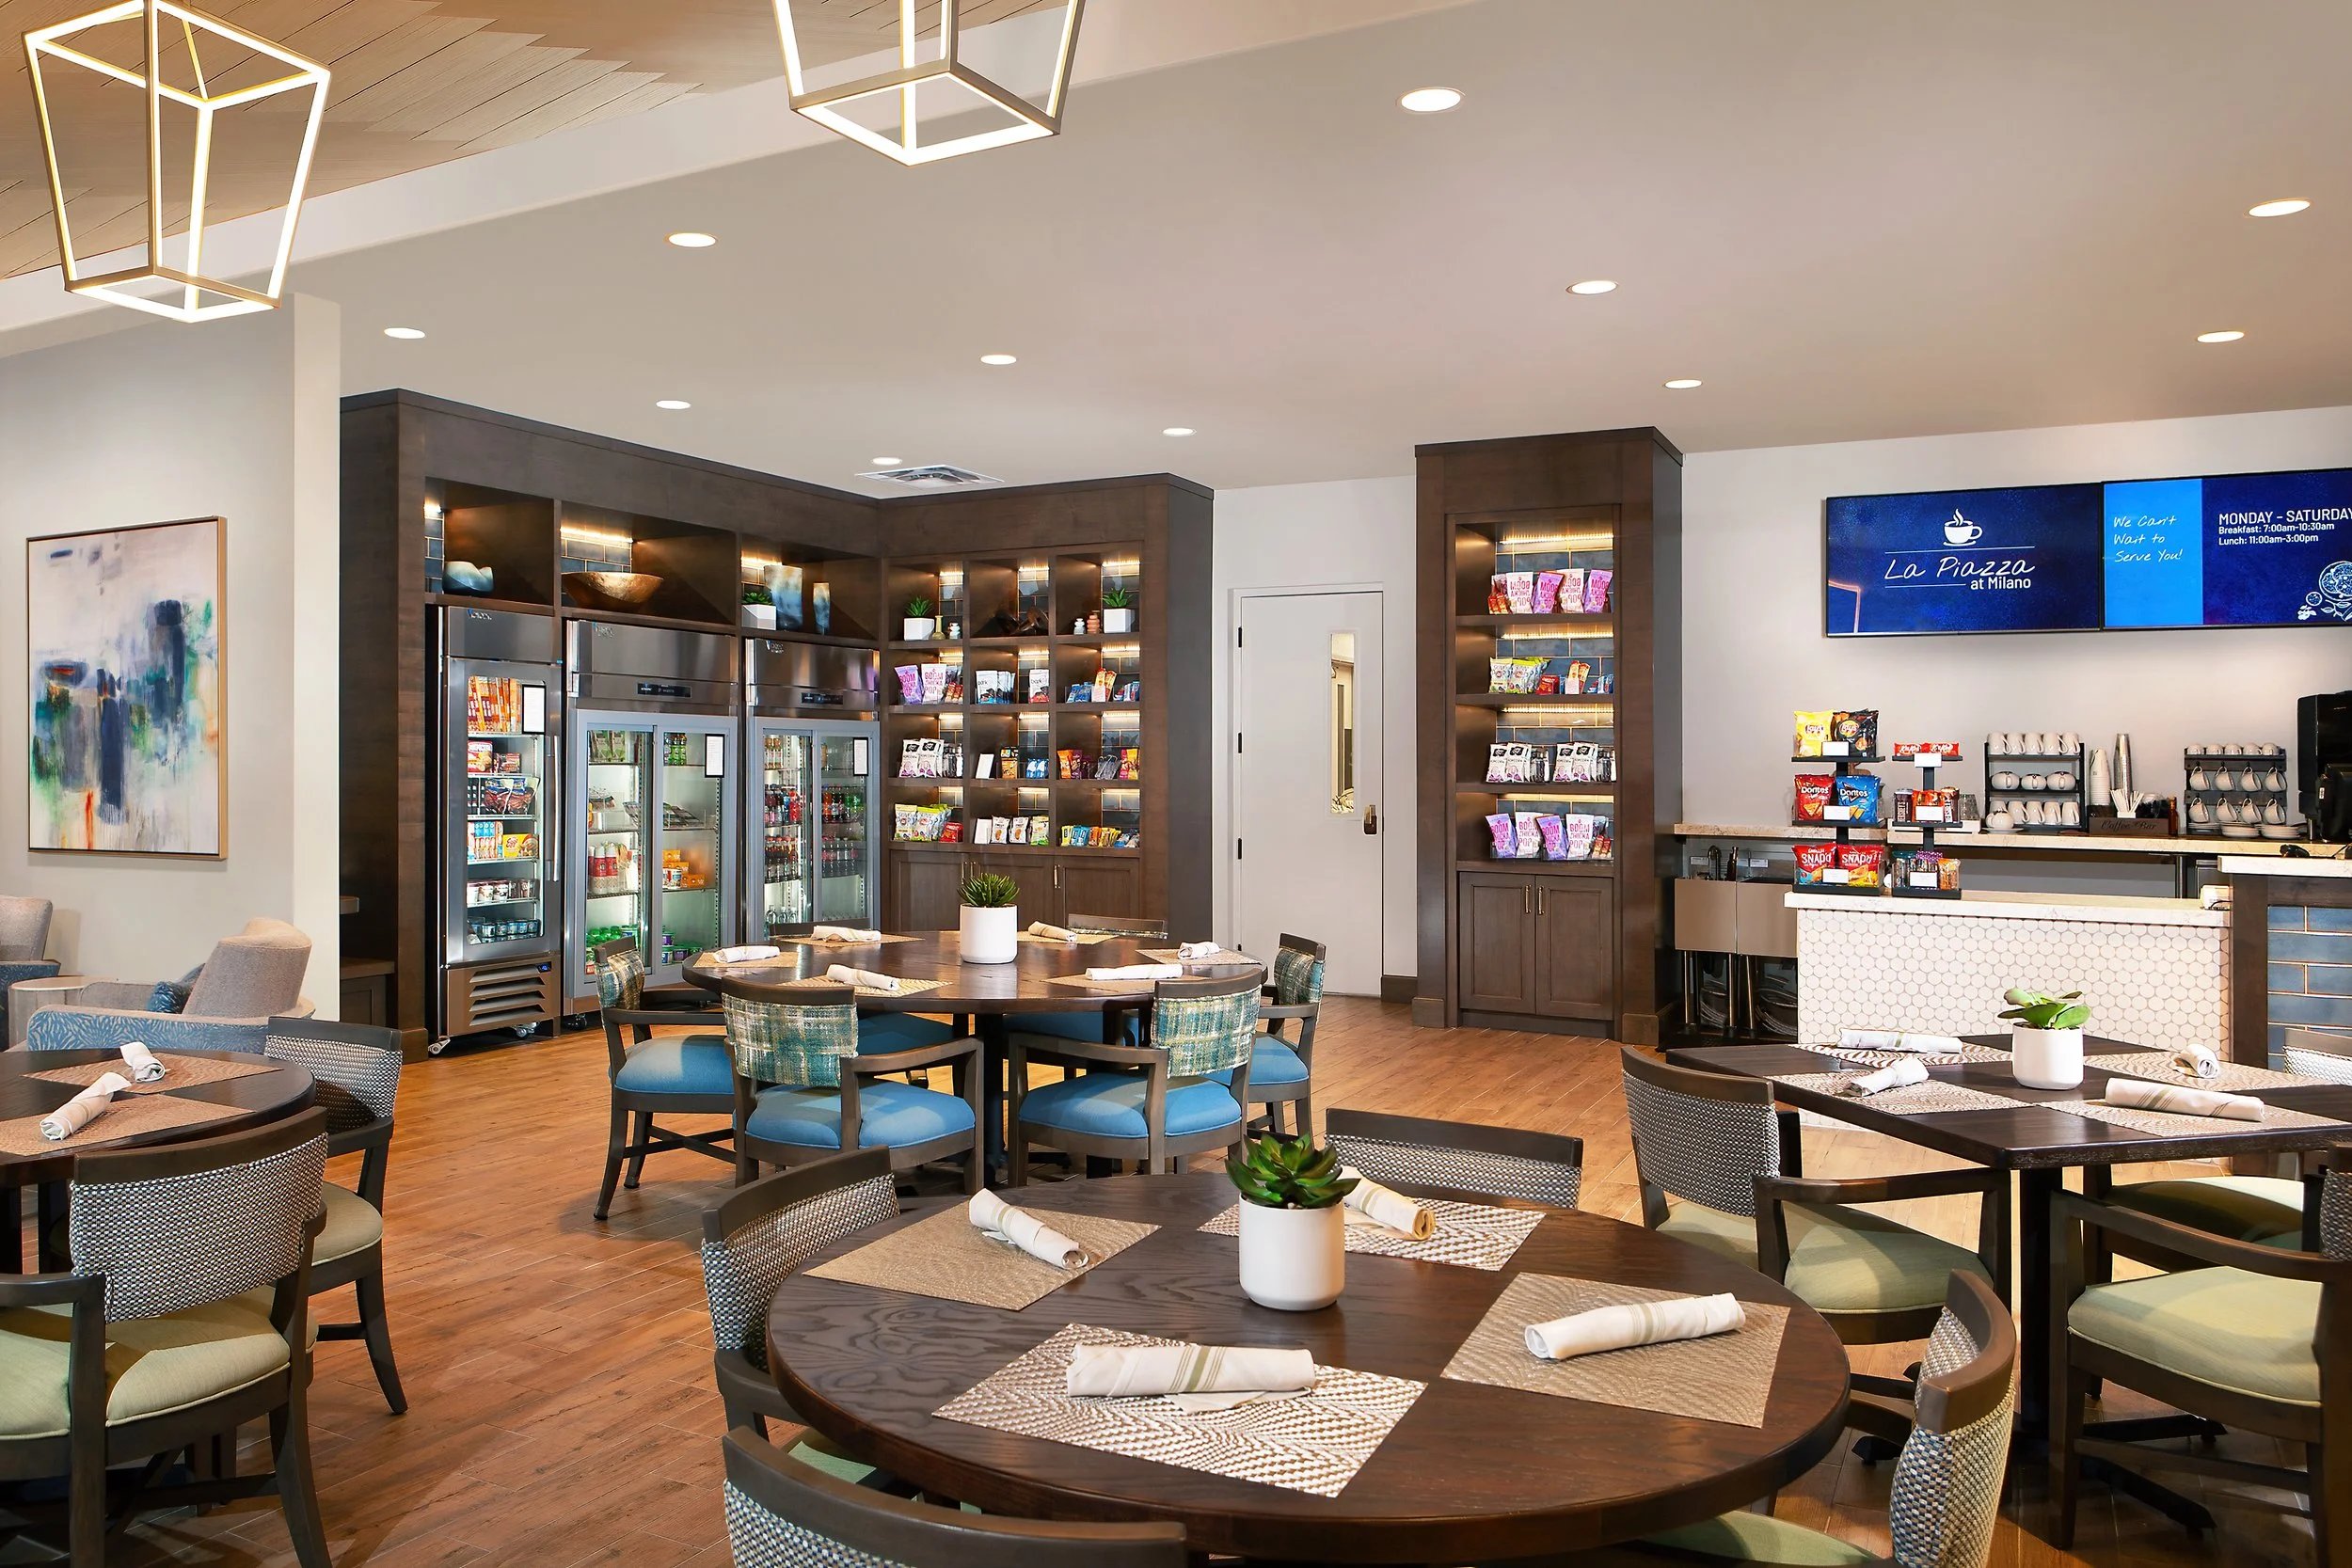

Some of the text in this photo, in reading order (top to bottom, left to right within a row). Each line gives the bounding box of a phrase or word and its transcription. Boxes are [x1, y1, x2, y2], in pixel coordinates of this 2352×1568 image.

[2114, 515, 2176, 527] We Can't
[2218, 511, 2273, 526] MONDAY
[2218, 522, 2335, 534] Breakfast: 7:00am-10:30am
[2114, 533, 2166, 545] Wait to
[2218, 533, 2319, 546] Lunch: 11:00am-3:00pm
[2115, 548, 2183, 562] Serve You!
[1884, 556, 2036, 579] La Piazza
[1970, 577, 2031, 590] at Milano
[2101, 819, 2157, 832] Coffee Bar
